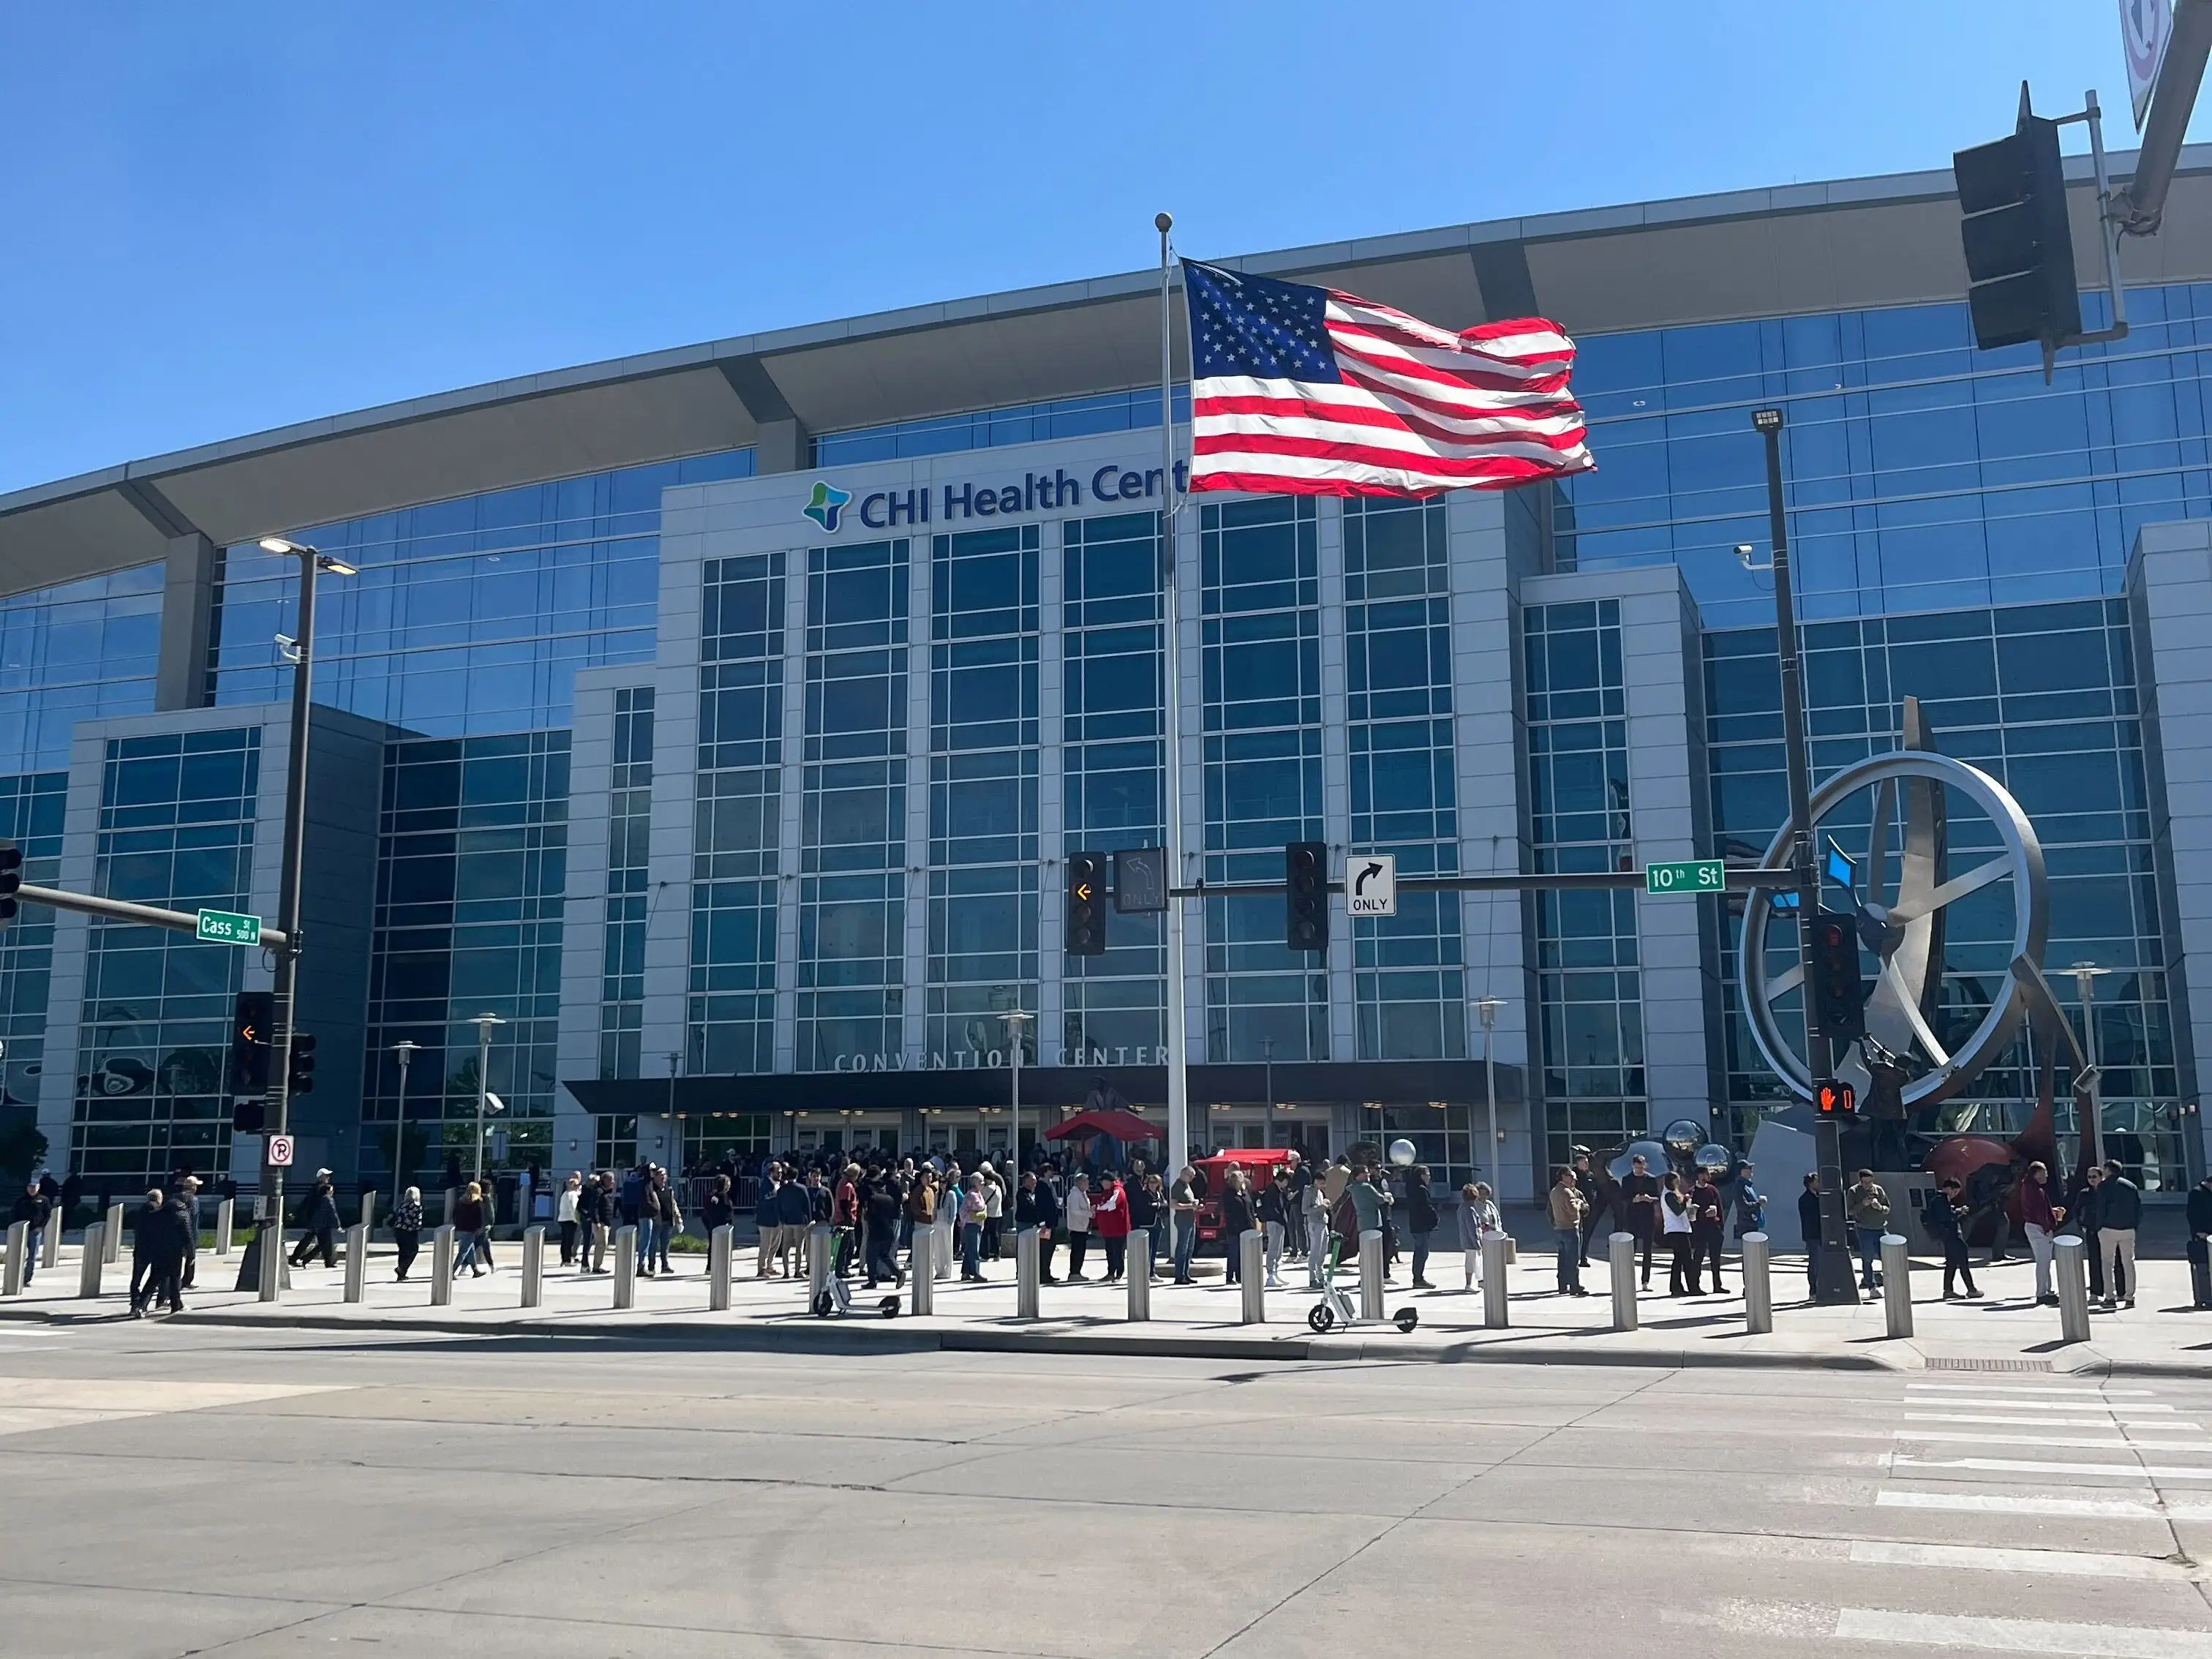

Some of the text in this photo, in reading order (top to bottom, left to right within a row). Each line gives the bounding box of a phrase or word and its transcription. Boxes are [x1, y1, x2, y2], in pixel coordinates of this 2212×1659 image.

[860, 488, 928, 528] CHI
[944, 469, 1079, 519] Health
[1652, 867, 1718, 887] 10th St
[1123, 892, 1161, 906] ONLY
[1353, 898, 1388, 911] ONLY
[201, 916, 232, 936] Cass
[236, 929, 249, 940] 500
[1055, 1046, 1169, 1066] CENTER
